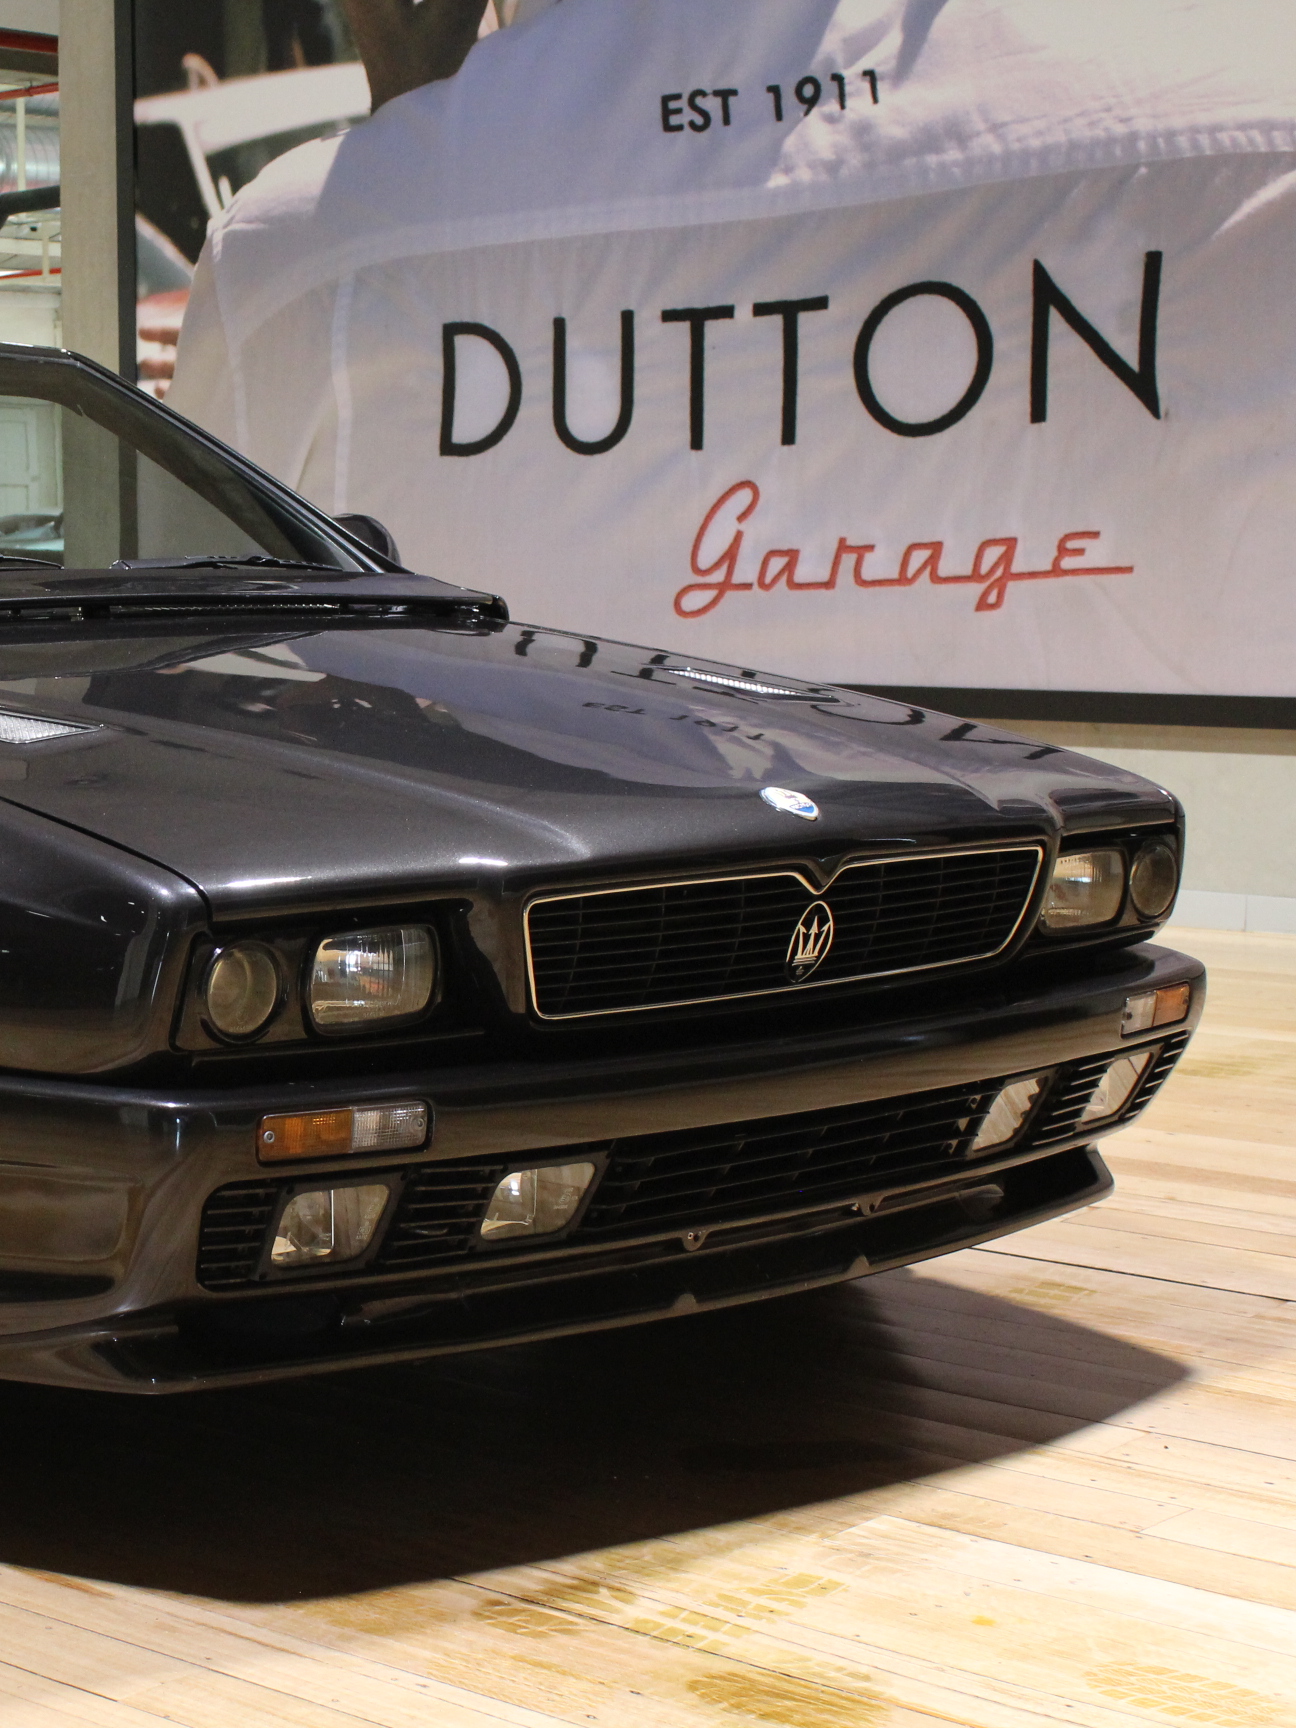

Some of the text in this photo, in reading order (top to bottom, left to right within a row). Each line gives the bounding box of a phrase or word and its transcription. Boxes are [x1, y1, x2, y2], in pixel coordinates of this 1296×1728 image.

[660, 69, 881, 133] EST 1911
[439, 249, 1164, 458] DUTTON
[673, 480, 1134, 619] Garage
